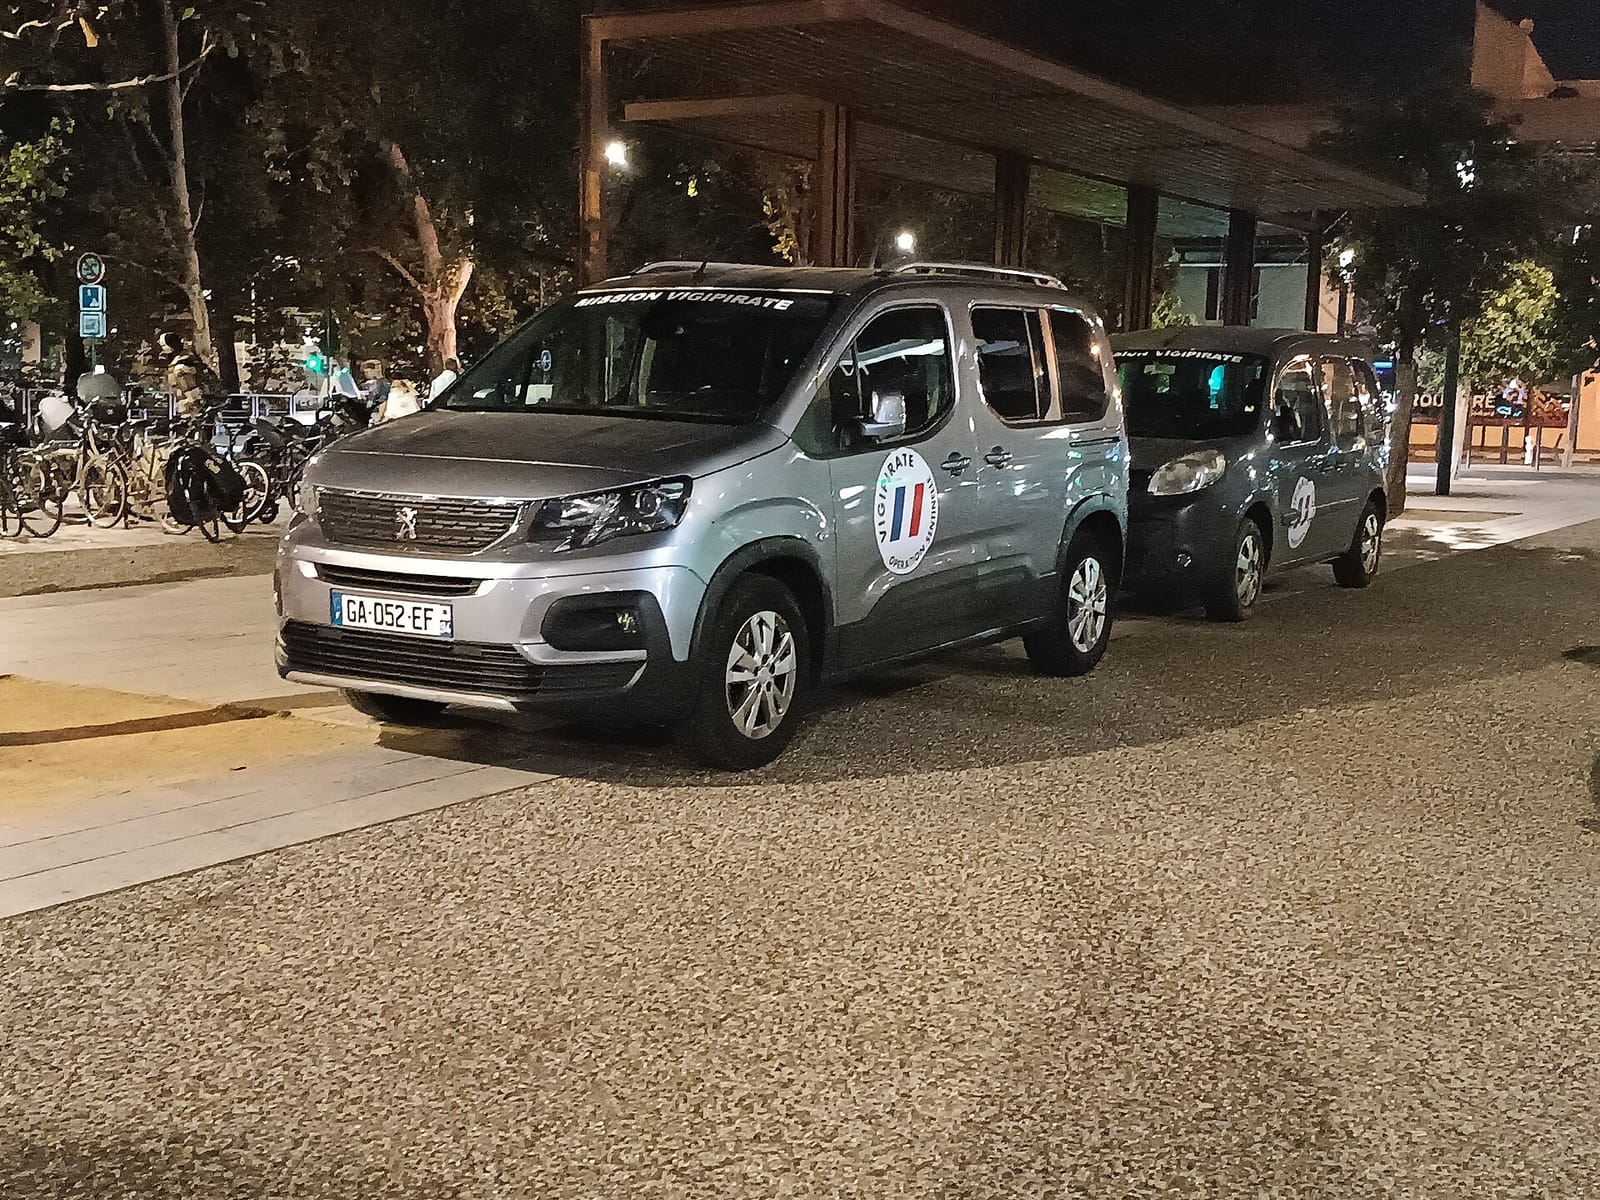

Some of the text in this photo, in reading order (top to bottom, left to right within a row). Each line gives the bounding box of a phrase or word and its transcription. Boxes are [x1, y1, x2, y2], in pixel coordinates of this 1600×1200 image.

[574, 291, 794, 311] MISSION VIGIPIRATE
[1155, 350, 1243, 363] VIGIPIRATE
